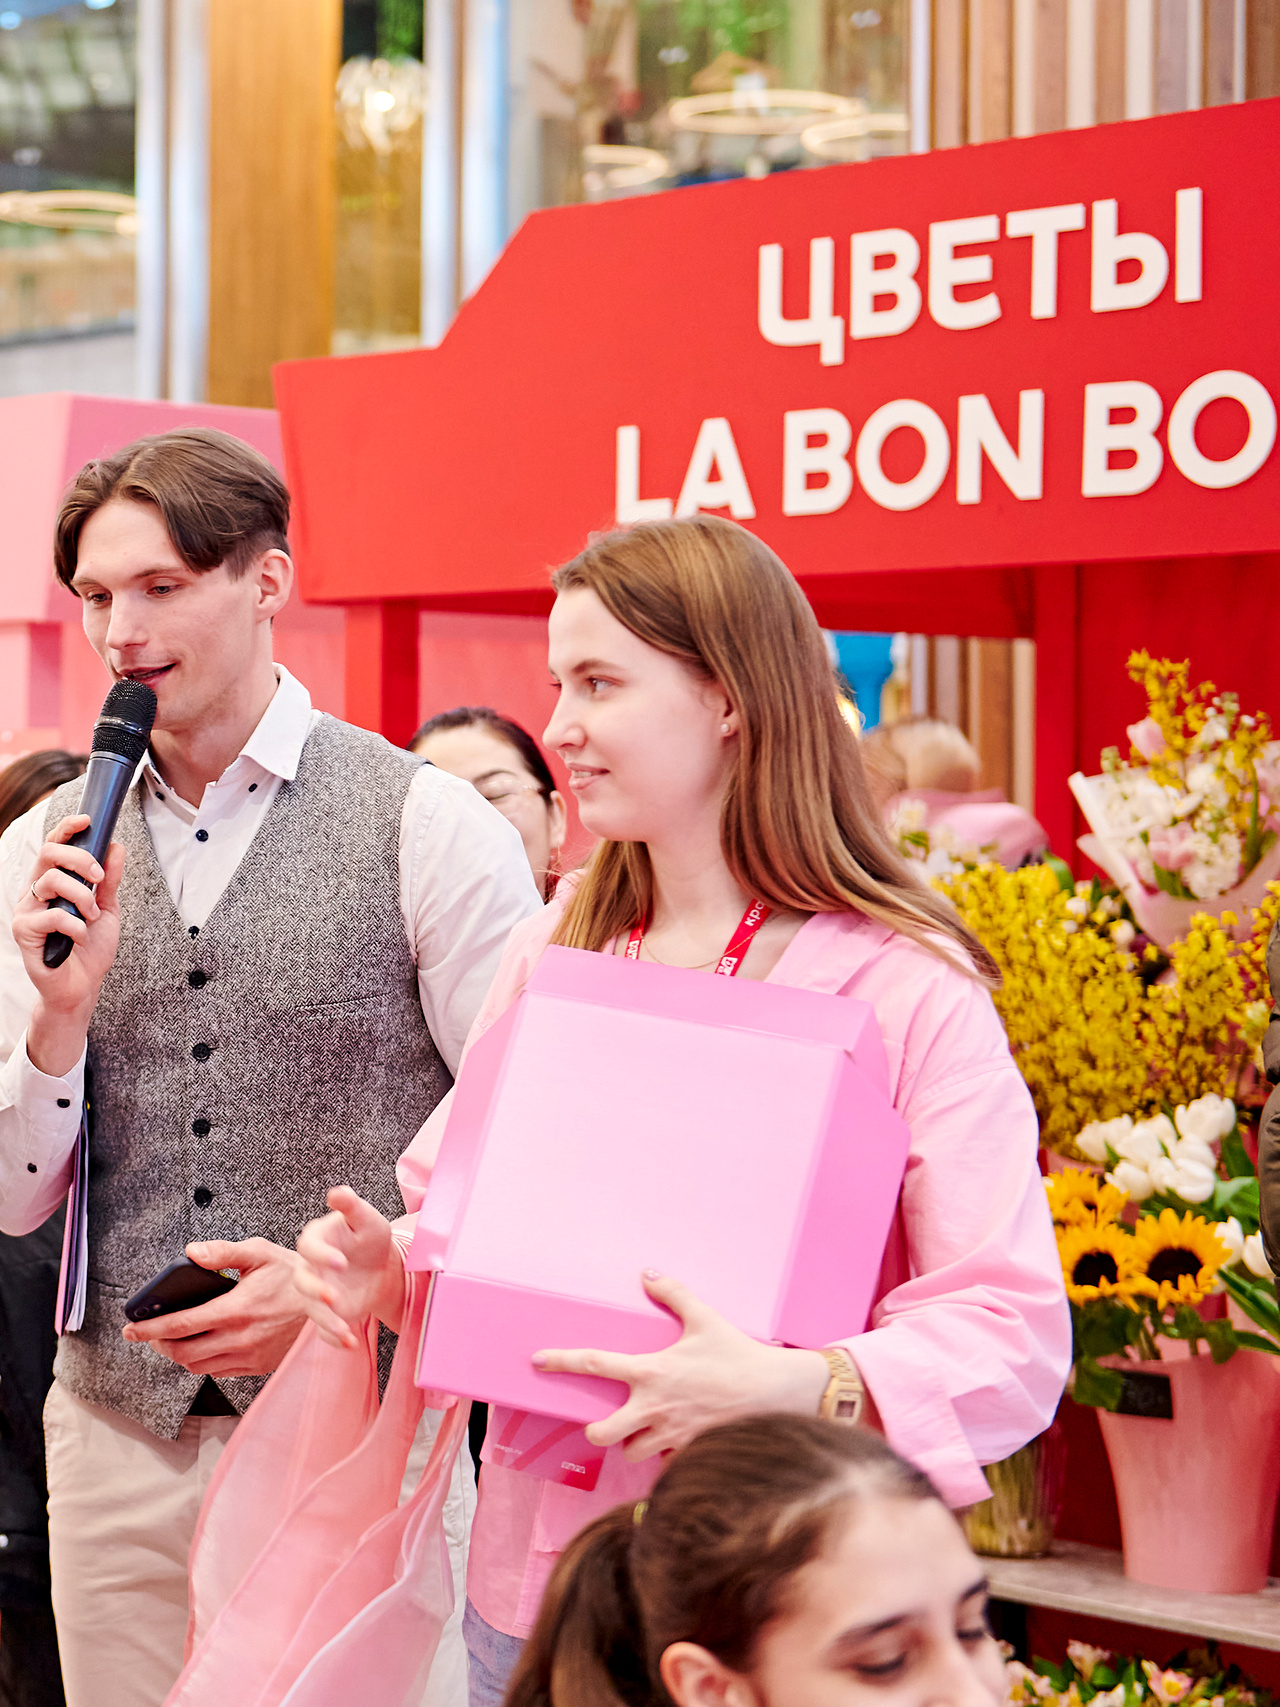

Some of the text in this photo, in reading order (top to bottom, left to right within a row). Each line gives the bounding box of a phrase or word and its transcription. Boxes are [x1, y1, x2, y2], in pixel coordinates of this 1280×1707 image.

[758, 186, 1203, 366] ЦВЕТЫ
[616, 370, 1278, 526] LA BON BO
